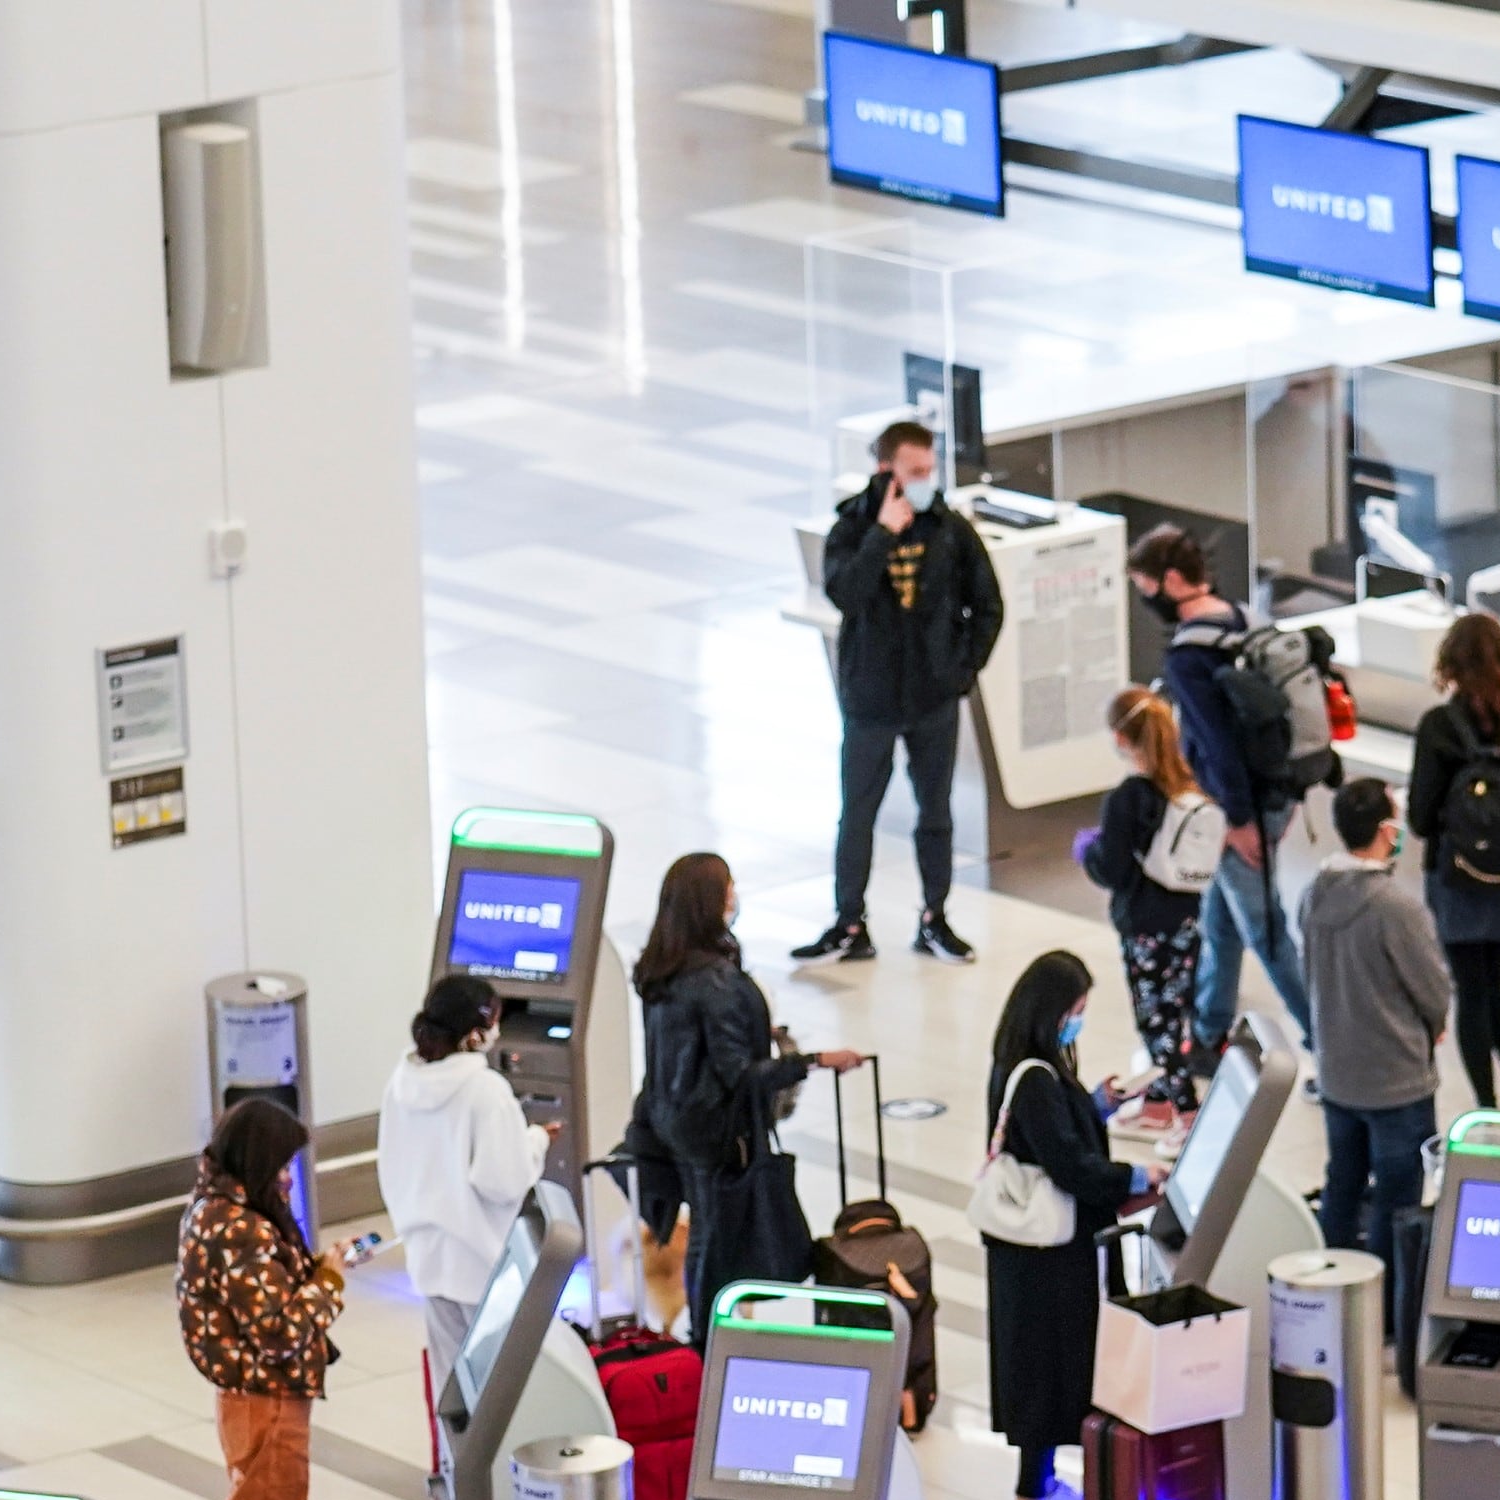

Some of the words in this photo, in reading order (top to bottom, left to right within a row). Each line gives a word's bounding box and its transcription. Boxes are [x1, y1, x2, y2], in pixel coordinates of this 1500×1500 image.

[1271, 184, 1366, 222] UNITED
[465, 901, 541, 924] UNITED
[732, 1396, 823, 1420] UNITED
